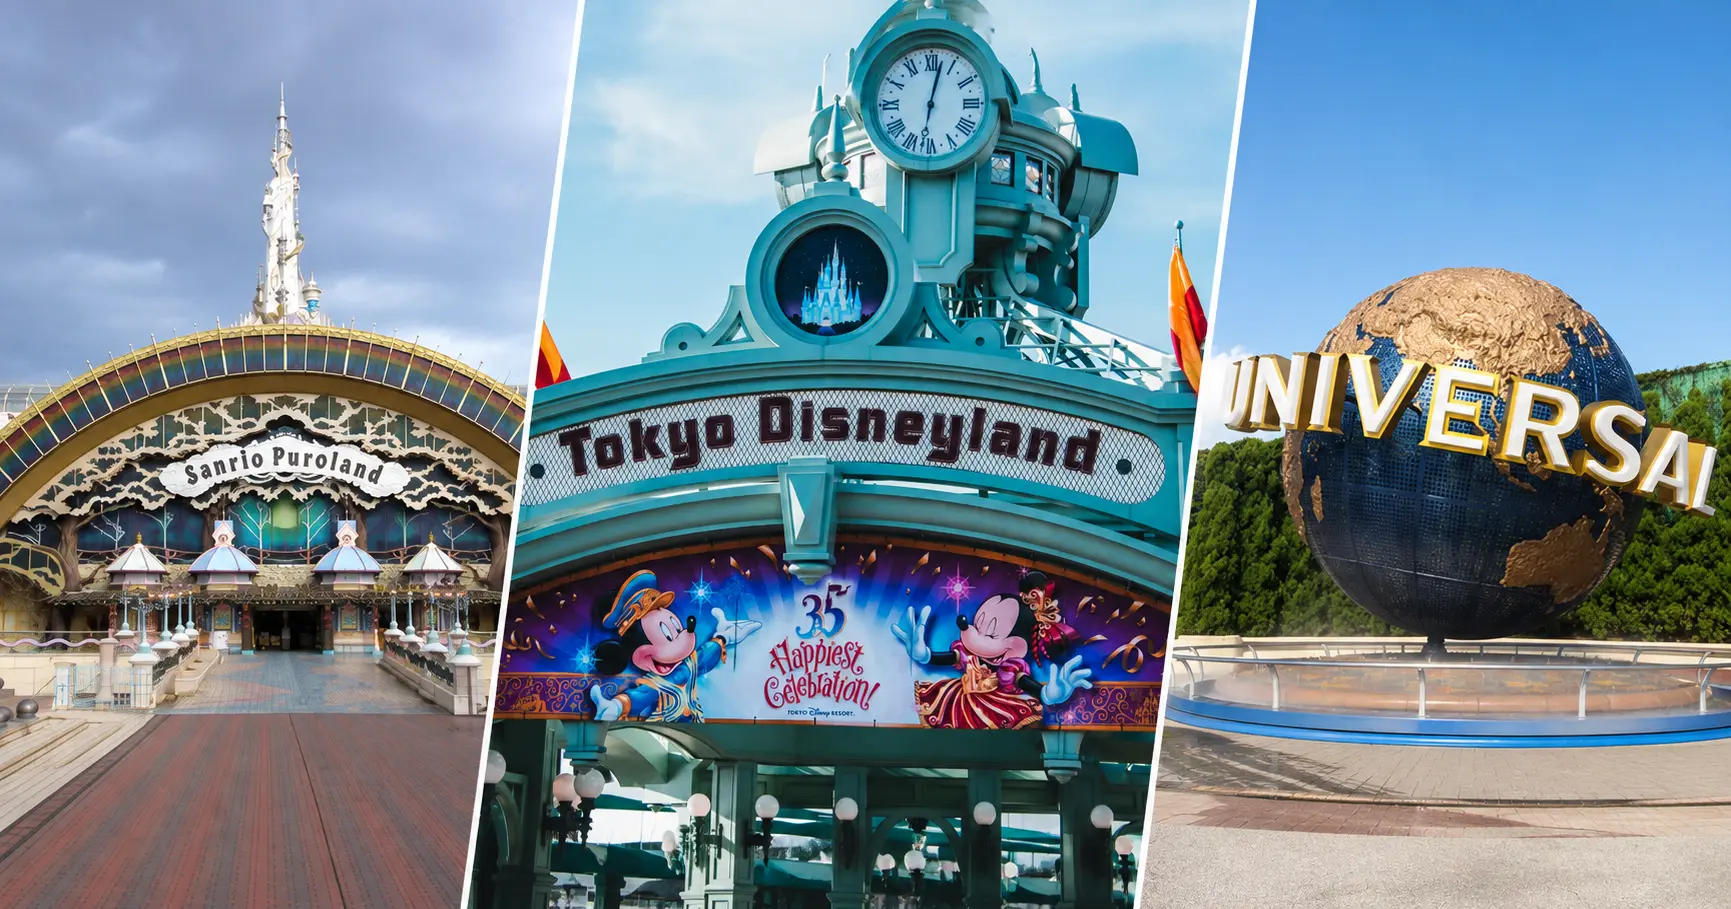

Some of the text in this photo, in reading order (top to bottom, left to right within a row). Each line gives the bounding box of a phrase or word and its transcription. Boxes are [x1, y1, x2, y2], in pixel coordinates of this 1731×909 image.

[903, 59, 918, 77] XI
[924, 54, 938, 71] XII
[889, 80, 905, 90] X
[957, 76, 974, 89] II
[882, 99, 899, 111] IX
[962, 98, 979, 110] III
[901, 132, 918, 152] VII
[926, 138, 936, 154] VI
[558, 395, 1101, 477] Tokyo Disneyland
[1223, 351, 1717, 517] UNIVERSAL
[184, 446, 385, 486] Sanrio Puroland
[795, 583, 851, 639] 35
[769, 637, 865, 676] Happiest
[764, 670, 880, 711] Celebration!
[808, 706, 831, 718] Disney
